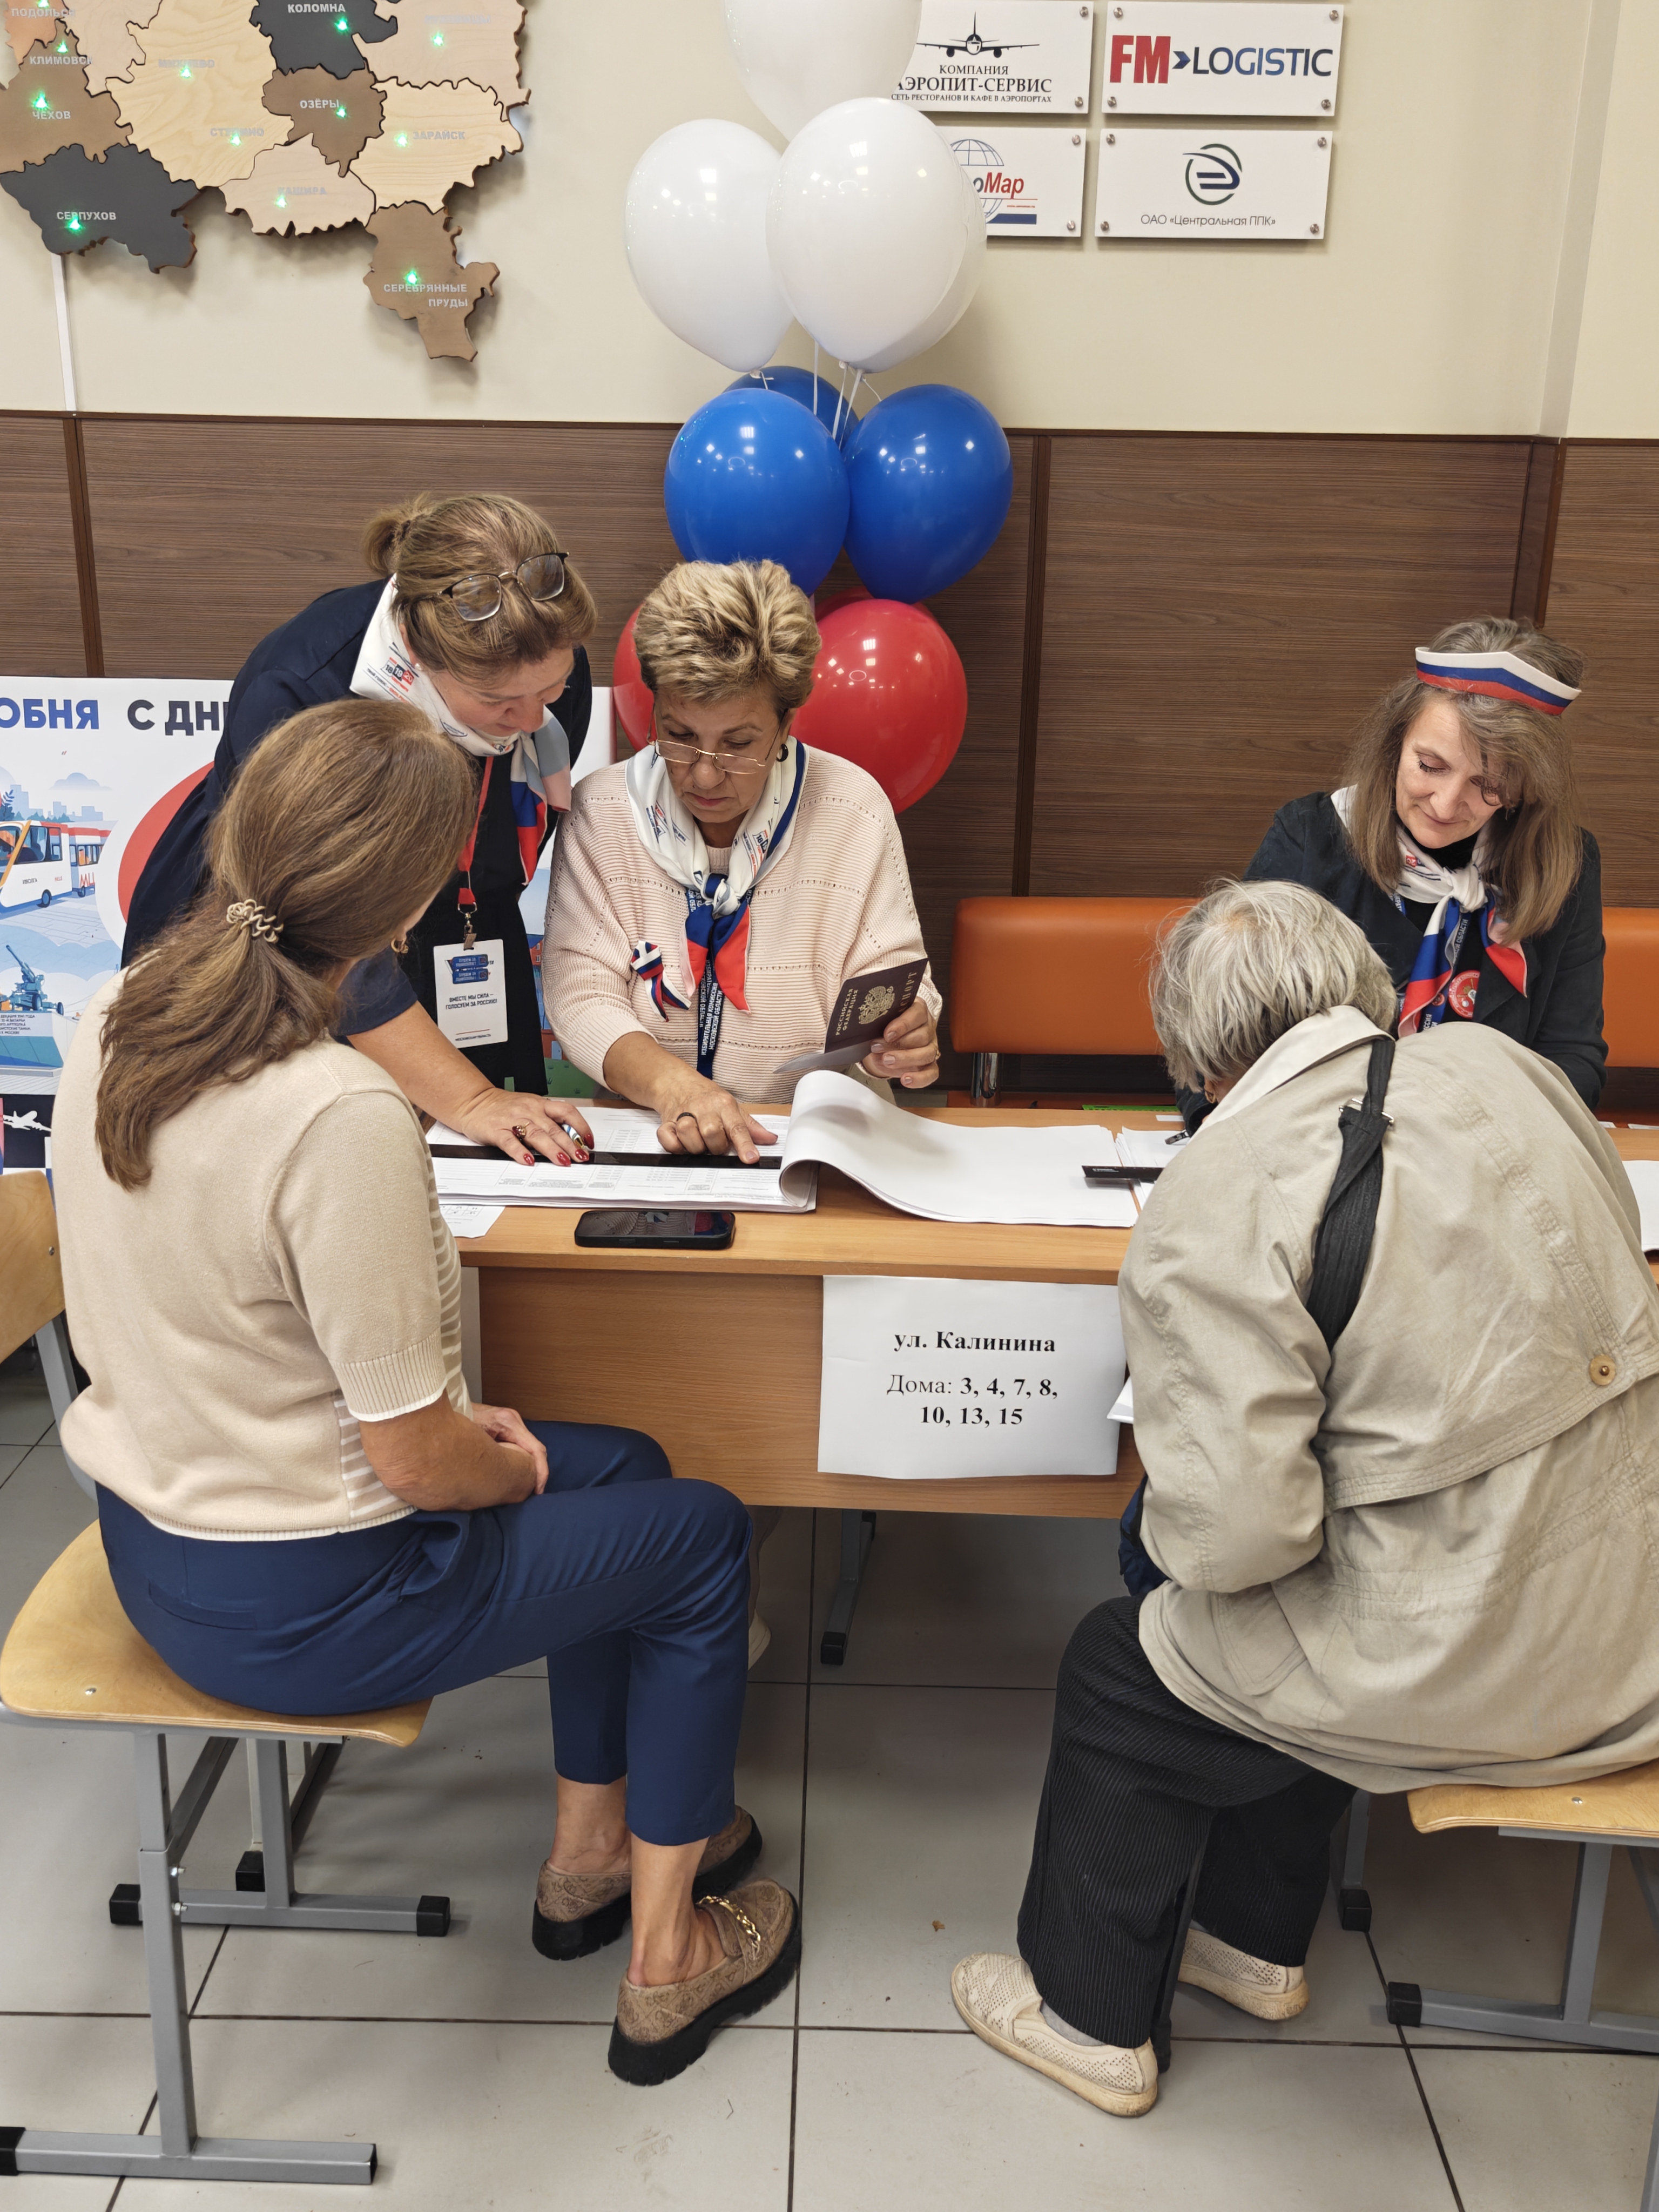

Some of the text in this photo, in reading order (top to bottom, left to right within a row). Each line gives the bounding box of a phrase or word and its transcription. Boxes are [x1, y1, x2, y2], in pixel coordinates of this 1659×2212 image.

[288, 3, 346, 13] КОЛОМНА
[30, 56, 92, 65] КЛИМОВСК
[939, 65, 1009, 75] КОМПАНИЯ
[1110, 35, 1334, 84] FM LOGISTIC
[300, 98, 340, 109] ОЗЁРЫ
[32, 111, 71, 119] ЧЕХОВ
[973, 172, 1024, 199] oMap
[56, 211, 117, 220] СЕРПУХОВ
[1141, 214, 1276, 227] ОАО «Центральная ППК»
[383, 284, 468, 293] СЕРЕБРЯННЫЕ
[428, 298, 468, 309] ПРУДЫ
[0, 697, 99, 730] ОБНЯ
[127, 699, 156, 731] С
[898, 972, 917, 1012] СПОРТ
[835, 988, 853, 1036] РОССИЙСКАЯ
[842, 989, 859, 1031] ФЕДЕРАЦИЯ
[894, 1331, 1056, 1352] ул. Калинина
[886, 1374, 1057, 1399] Дома: 3, 4, 7, 8,
[920, 1406, 1023, 1427] 10, 13, 15
